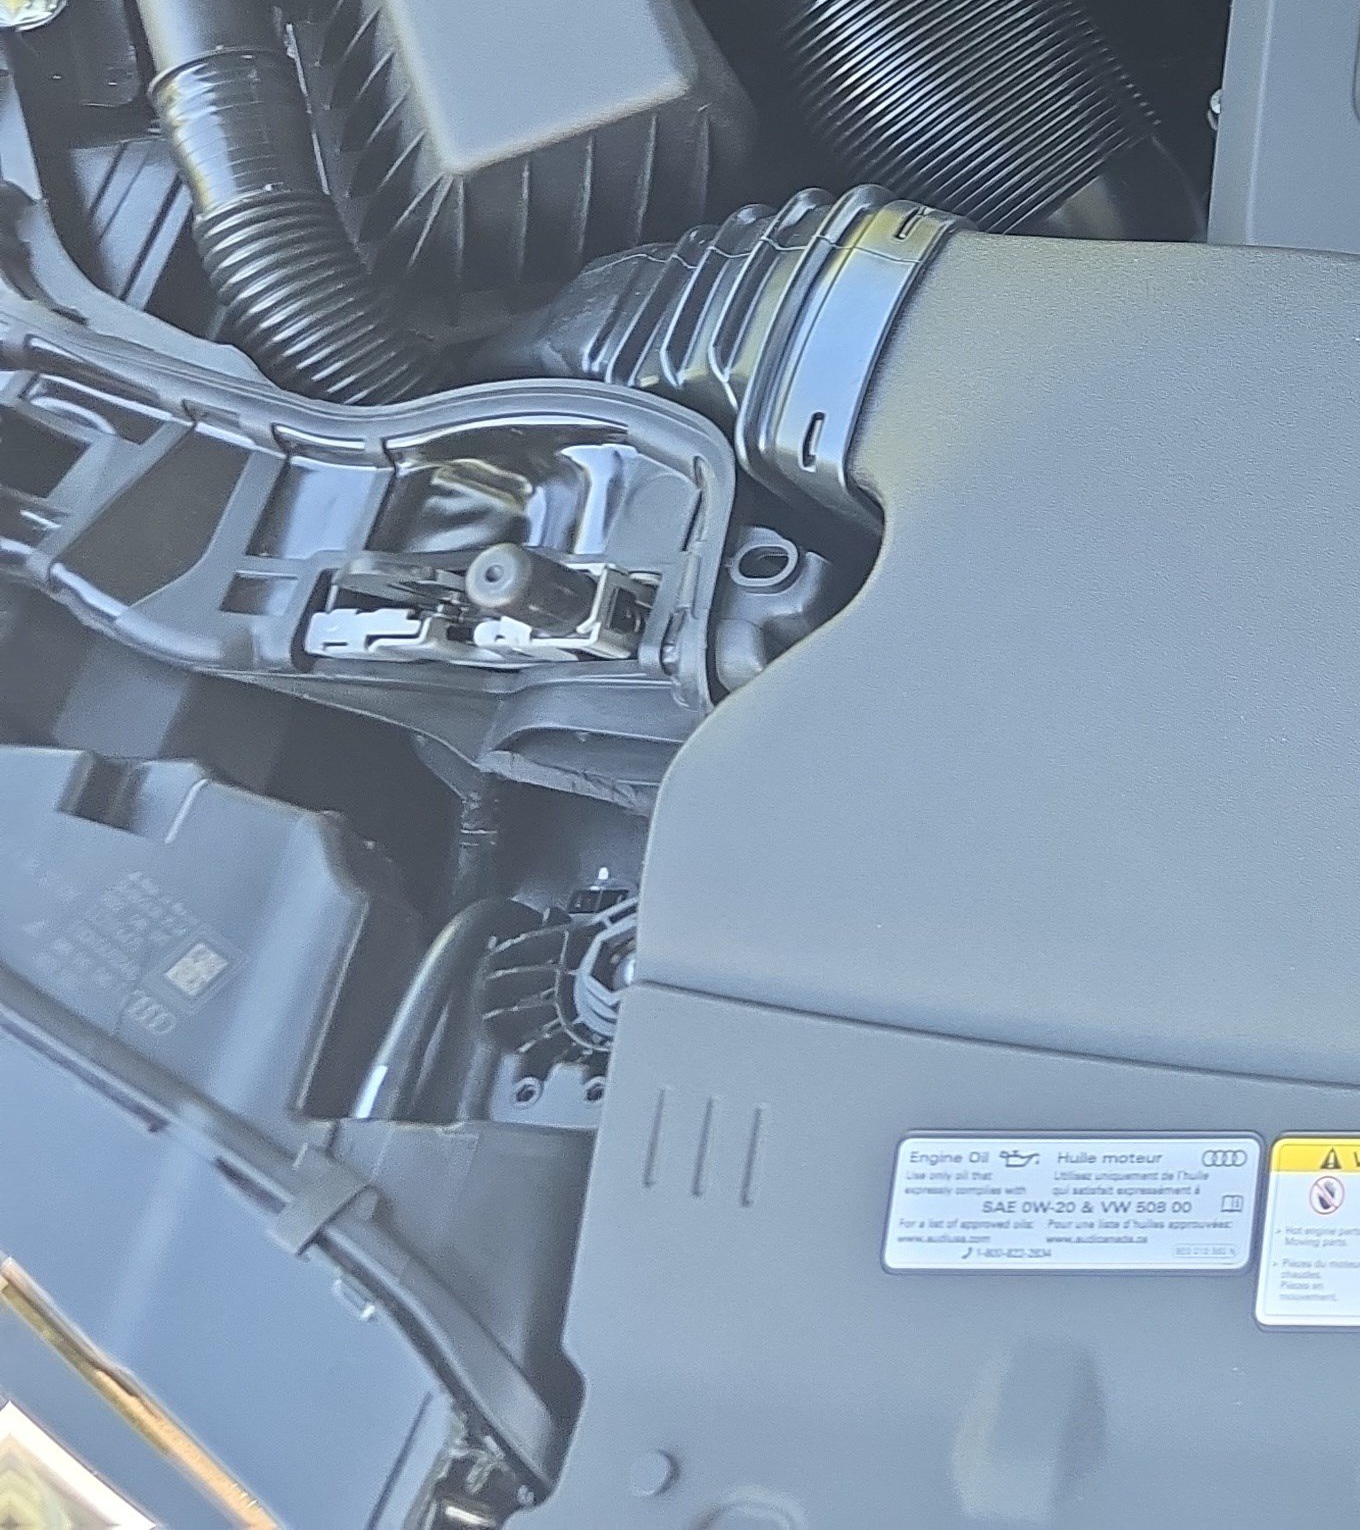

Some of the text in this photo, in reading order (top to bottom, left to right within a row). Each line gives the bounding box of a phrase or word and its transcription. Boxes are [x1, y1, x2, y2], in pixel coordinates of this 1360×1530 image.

[910, 1151, 989, 1166] Engine Oil
[1057, 1152, 1163, 1164] Huile moteur
[982, 1201, 1192, 1213] SAE 0W-20 & VW 508 00
